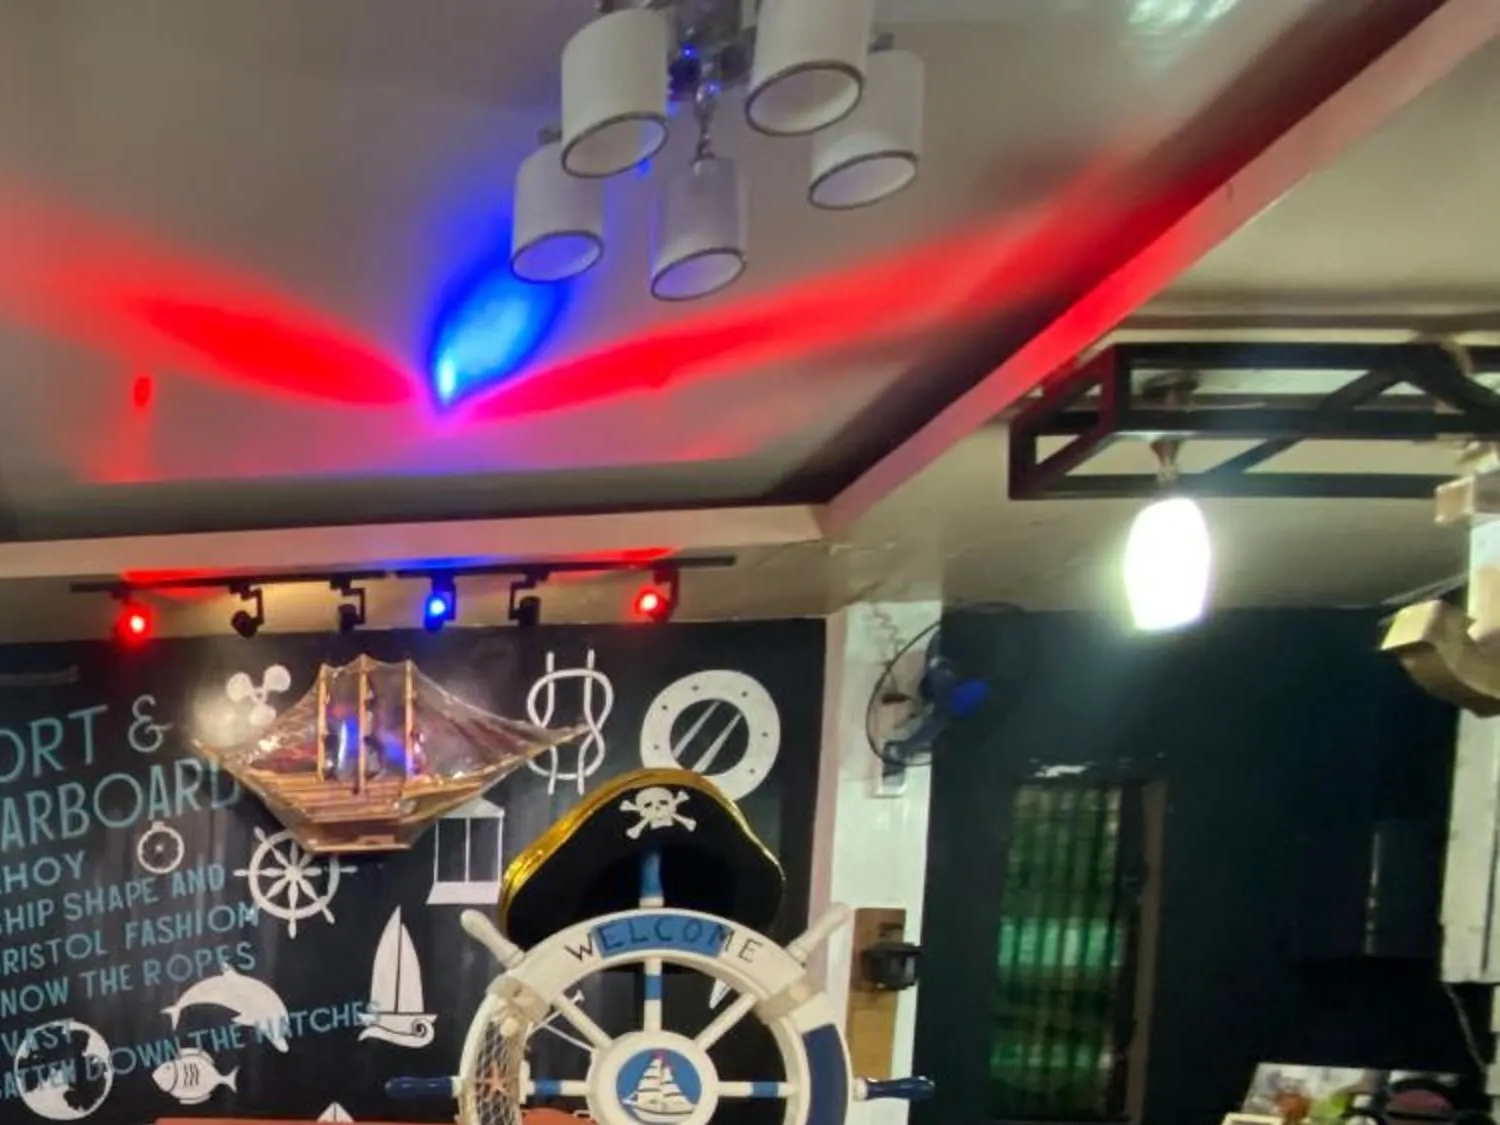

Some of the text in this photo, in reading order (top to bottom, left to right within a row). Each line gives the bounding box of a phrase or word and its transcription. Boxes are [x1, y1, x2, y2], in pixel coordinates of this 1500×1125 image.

[127, 694, 173, 753] &
[63, 877, 160, 922] SHAPE
[172, 863, 226, 898] AND
[564, 913, 764, 963] WELCOME
[81, 965, 133, 999] THE
[143, 941, 257, 987] ROPES
[84, 1035, 181, 1082] DOWN
[188, 1023, 245, 1053] THE
